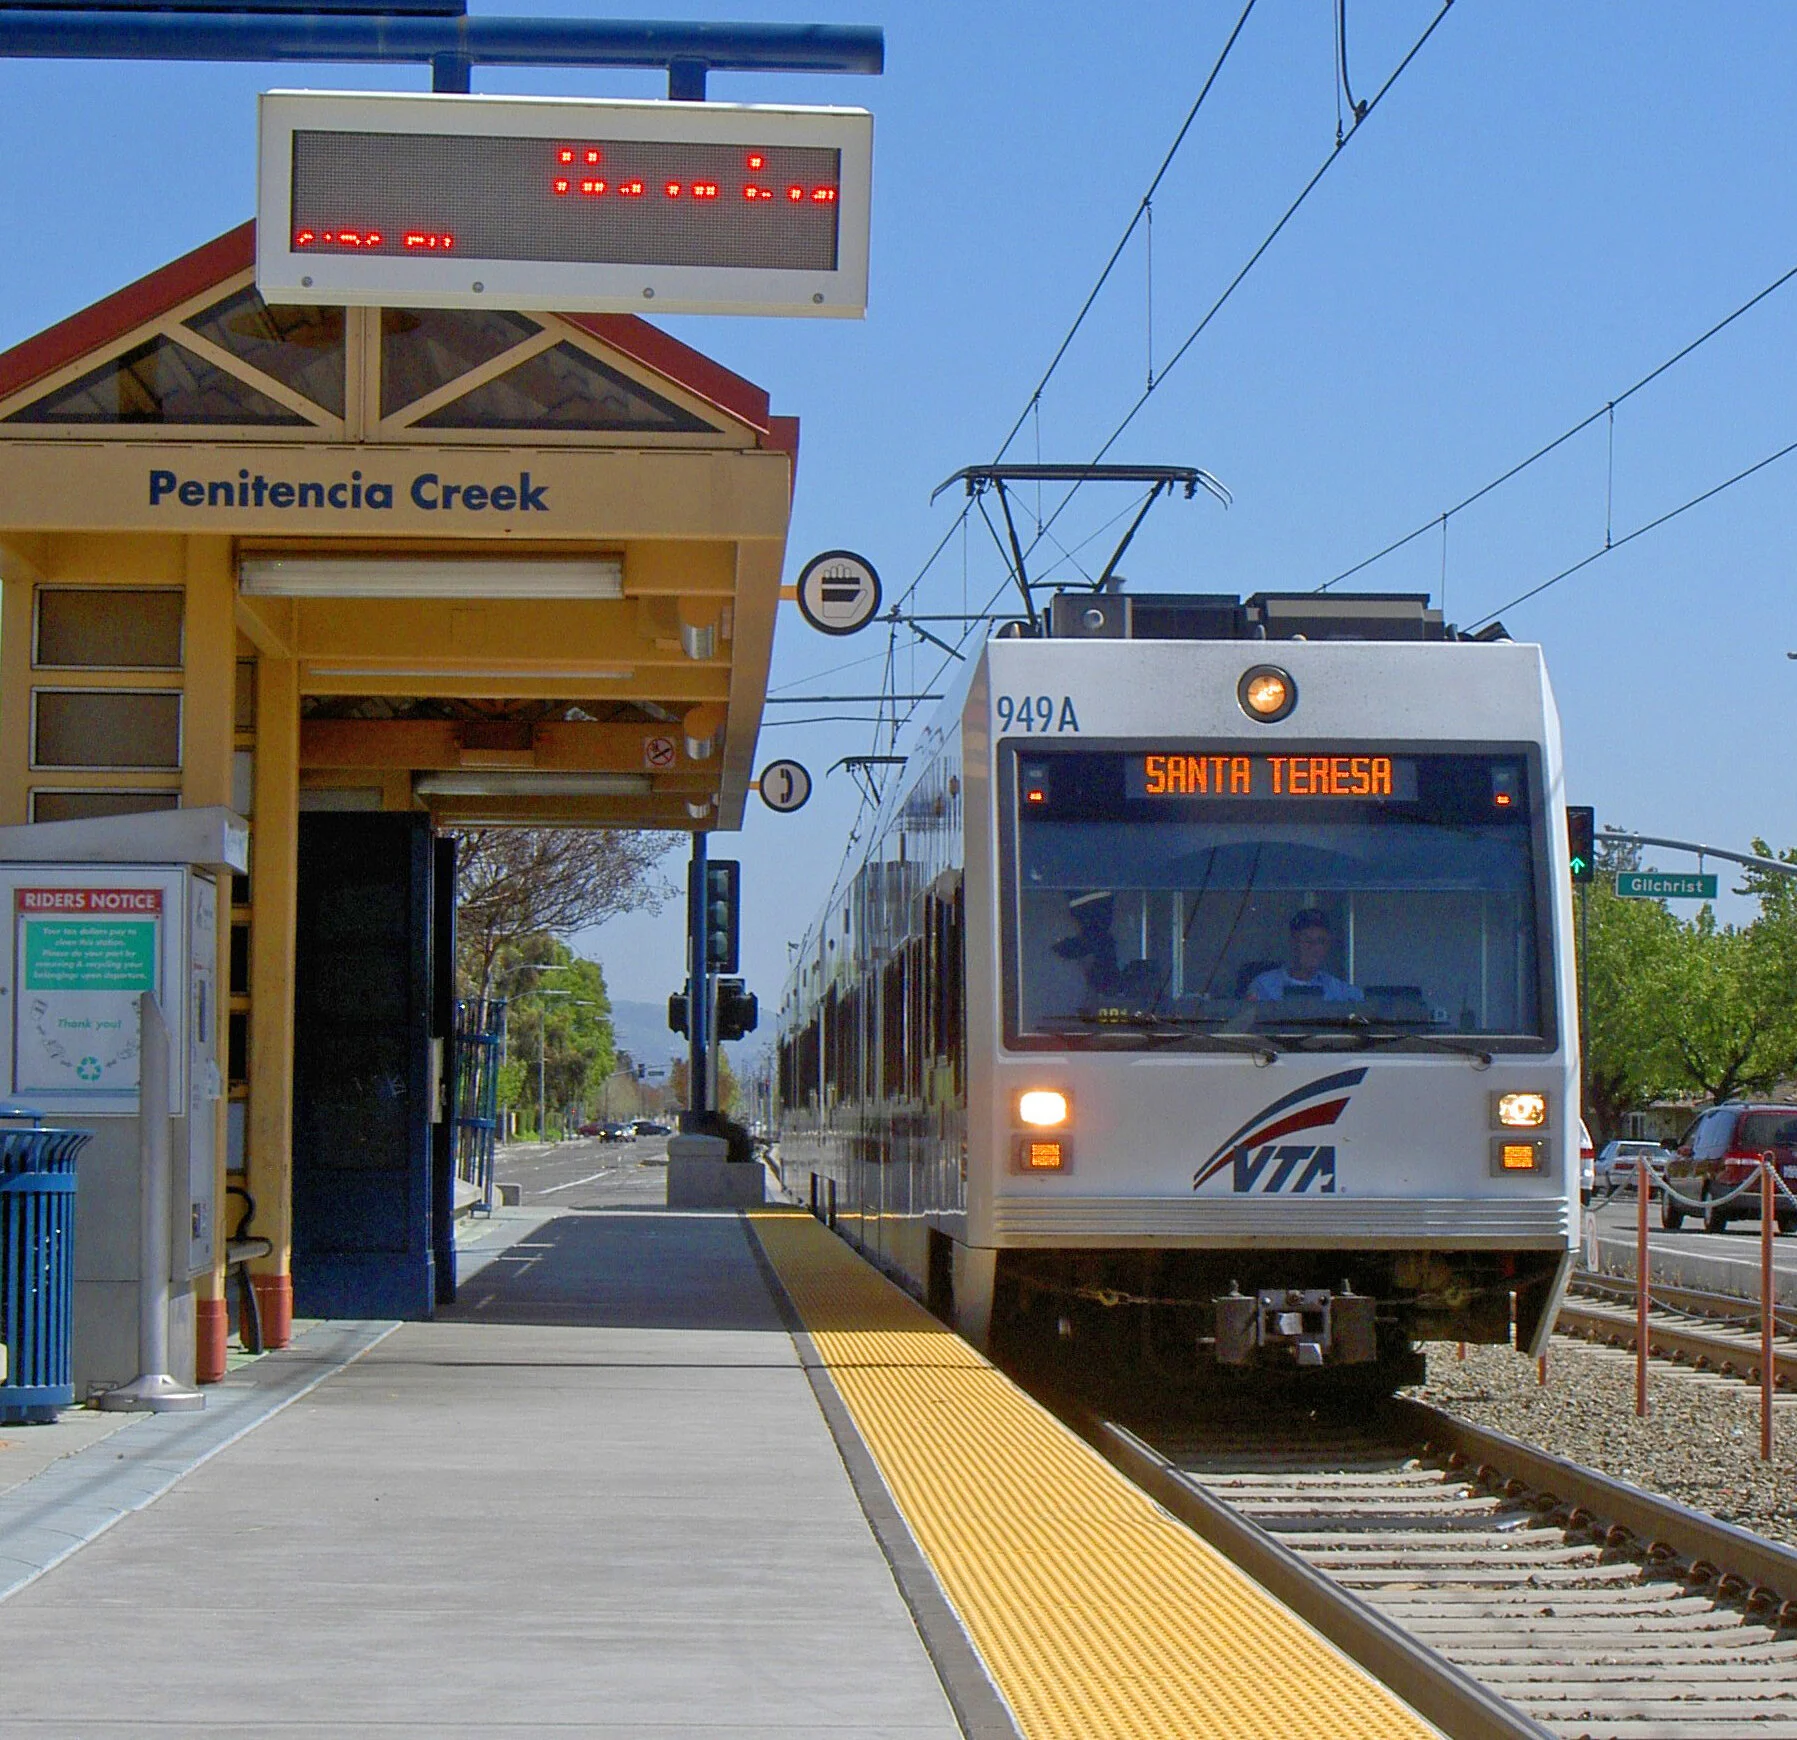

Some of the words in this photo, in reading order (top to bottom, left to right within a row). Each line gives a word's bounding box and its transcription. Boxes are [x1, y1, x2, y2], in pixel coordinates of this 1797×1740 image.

[149, 468, 393, 509] Penitencia
[410, 471, 550, 512] Creek
[996, 695, 1080, 733] 949A
[1144, 755, 1251, 794] SANTA
[1266, 756, 1392, 795] TERESA
[1631, 877, 1704, 893] Gilchrist
[24, 892, 86, 908] RIDERS
[91, 893, 155, 909] NOTICE
[43, 927, 61, 936] Your
[63, 928, 77, 936] tax
[80, 927, 107, 936] dollars
[109, 928, 126, 938] pay
[127, 928, 138, 936] to
[55, 938, 78, 947] clean
[80, 938, 93, 947] this
[96, 938, 126, 947] station.
[42, 949, 69, 957] Please
[71, 949, 82, 957] do
[84, 951, 104, 960] your
[105, 950, 123, 960] part
[34, 960, 76, 970] removing
[76, 960, 83, 969] &
[86, 960, 121, 970] recycling
[124, 961, 144, 970] your
[33, 970, 79, 981] belongings
[81, 972, 102, 981] upon
[104, 971, 147, 981] departure.
[57, 1016, 92, 1029] Thank
[95, 1018, 122, 1032] you!
[1233, 1145, 1336, 1193] VTA
